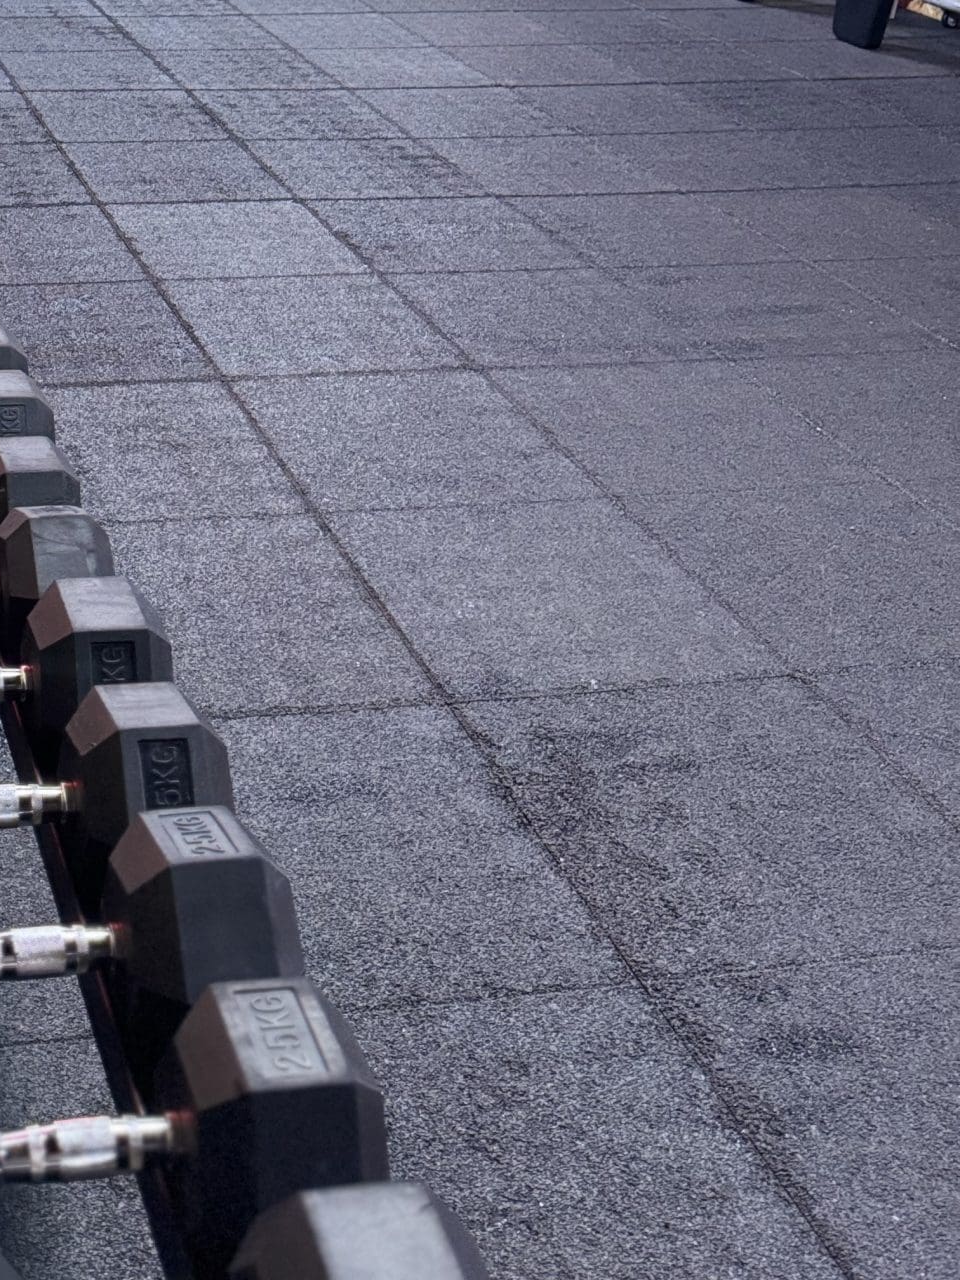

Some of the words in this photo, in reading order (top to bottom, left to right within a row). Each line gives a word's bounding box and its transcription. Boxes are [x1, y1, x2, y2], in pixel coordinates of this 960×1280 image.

[1, 408, 20, 432] KG
[102, 648, 125, 681] KG
[152, 747, 182, 806] 5KG
[174, 817, 225, 854] 25KG
[250, 995, 311, 1072] 25KG
